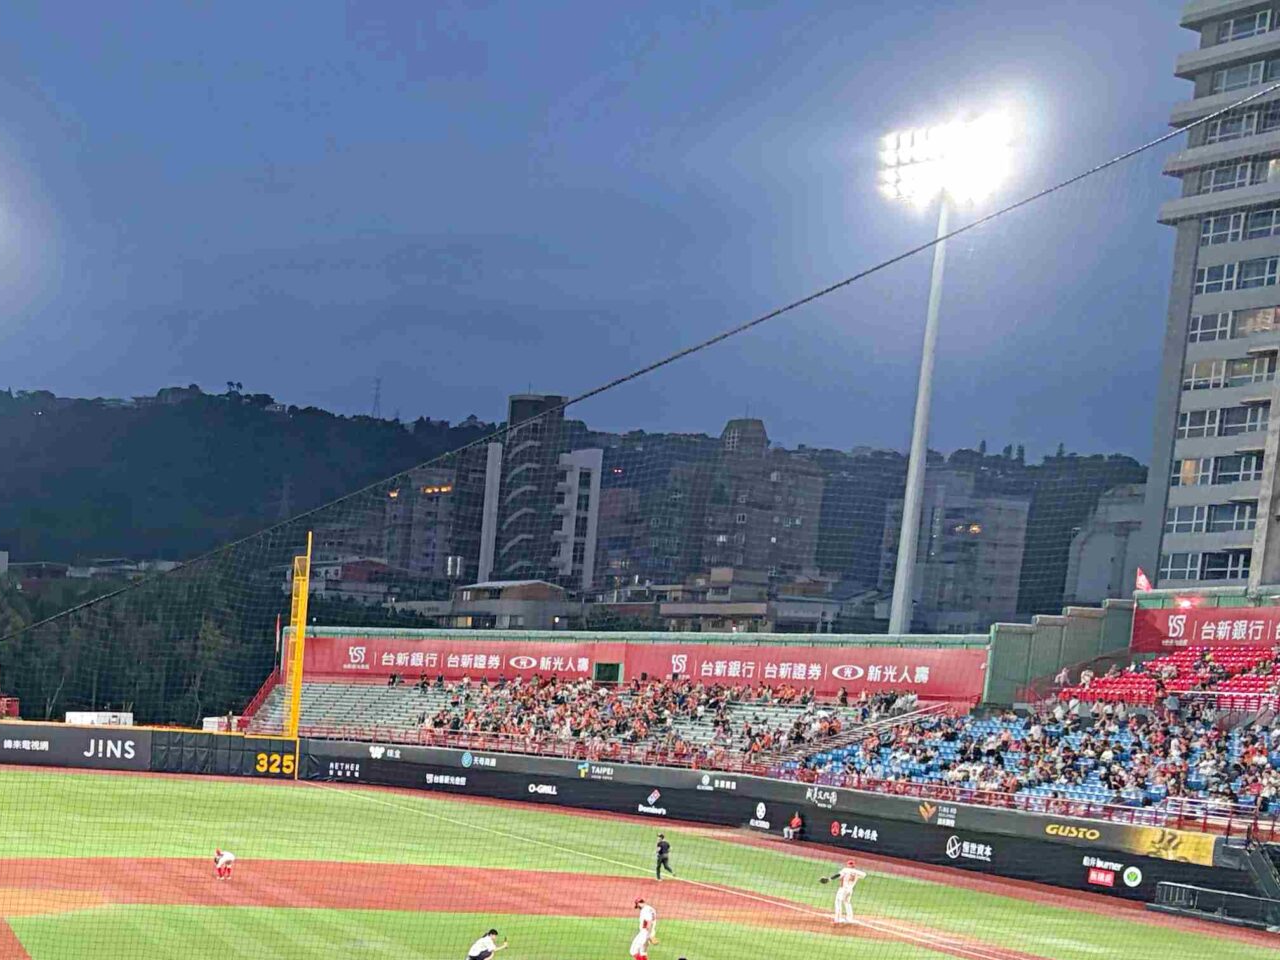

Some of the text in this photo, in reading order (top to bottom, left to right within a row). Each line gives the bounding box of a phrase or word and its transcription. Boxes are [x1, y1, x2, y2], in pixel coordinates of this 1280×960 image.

[1201, 620, 1265, 640] 台新銀行
[381, 652, 438, 667] 台新銀行
[447, 654, 501, 670] 台新證券
[539, 656, 589, 672] 新光人壽
[700, 660, 930, 683] 台新銀行 台新證券 新光人壽
[3, 739, 49, 751] 緯來電視網
[255, 754, 295, 774] 325
[591, 765, 614, 776] TAIPEI
[1045, 824, 1100, 840] GUSTO
